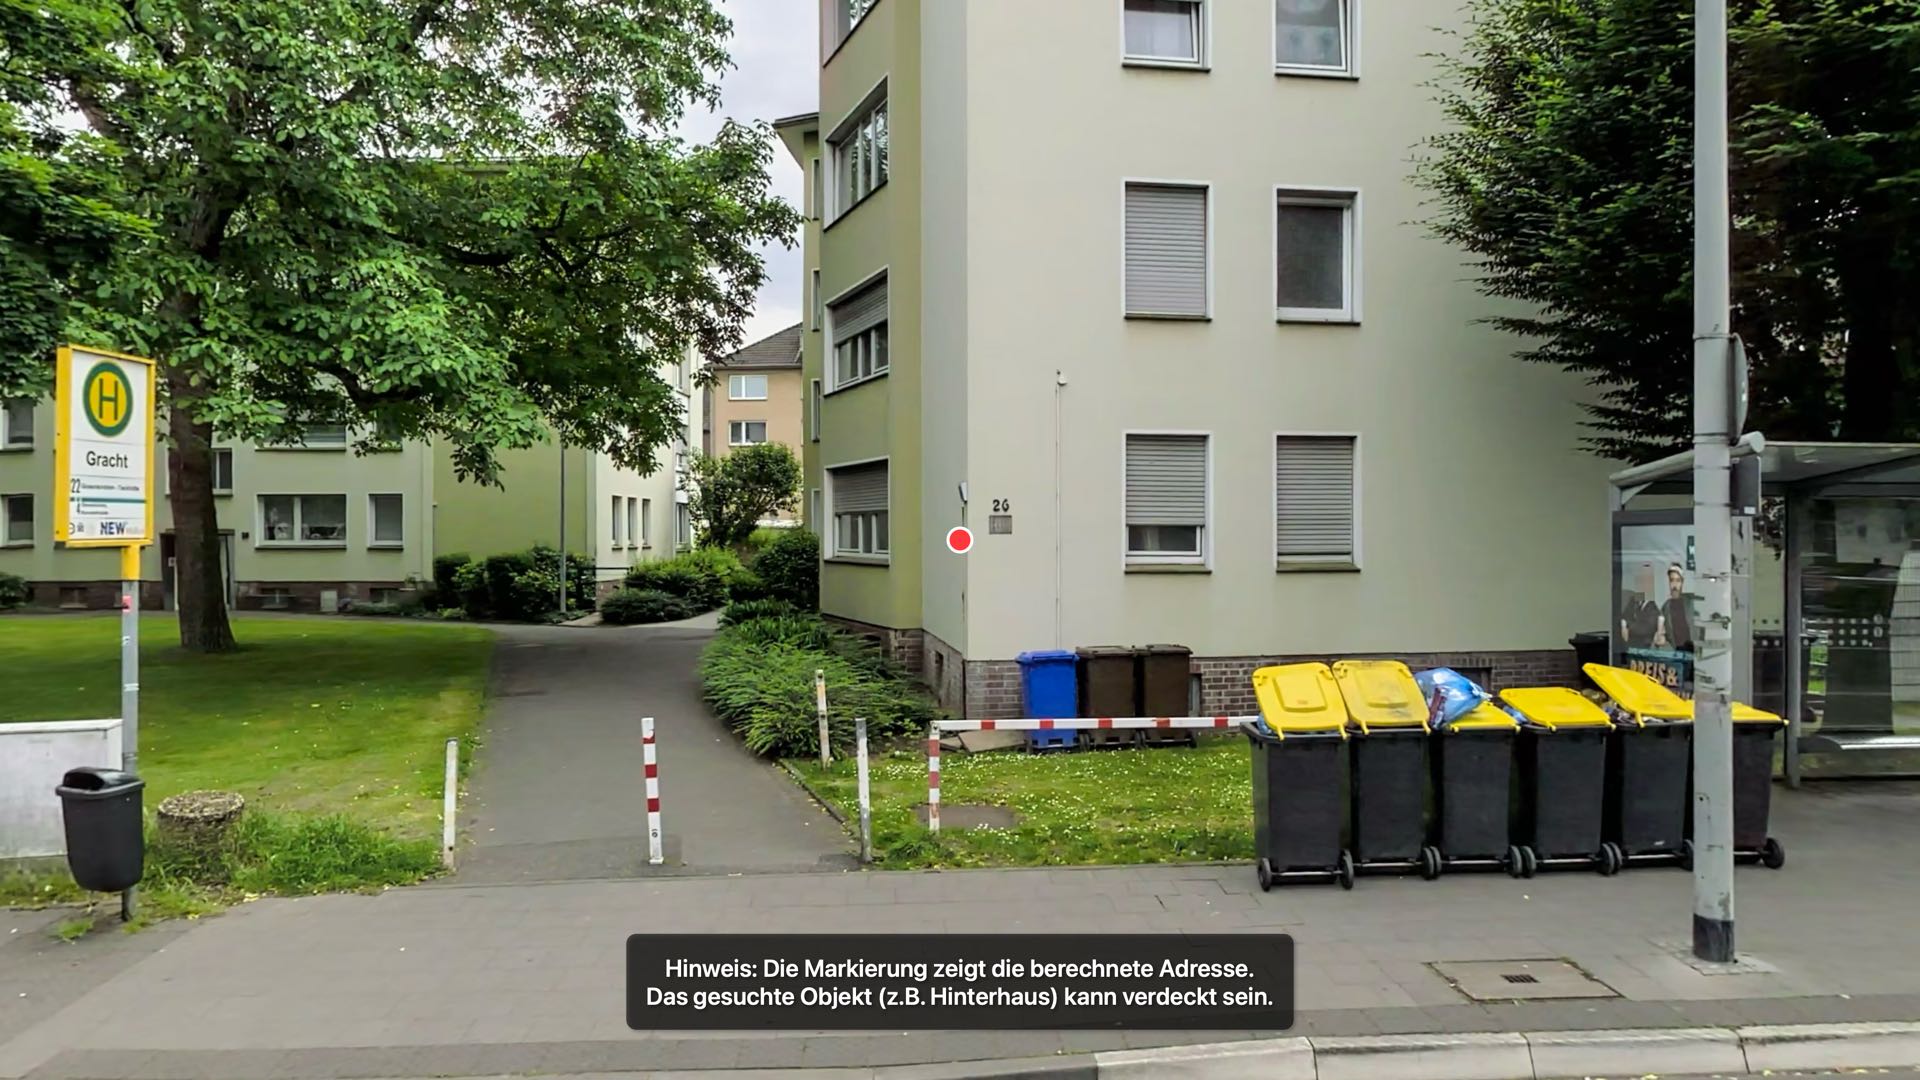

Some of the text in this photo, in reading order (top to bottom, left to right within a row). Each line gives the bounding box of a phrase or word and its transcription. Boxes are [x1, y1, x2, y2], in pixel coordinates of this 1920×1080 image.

[98, 378, 119, 421] H
[86, 450, 128, 469] Gracht
[993, 498, 1010, 512] 26
[101, 521, 127, 535] NEW
